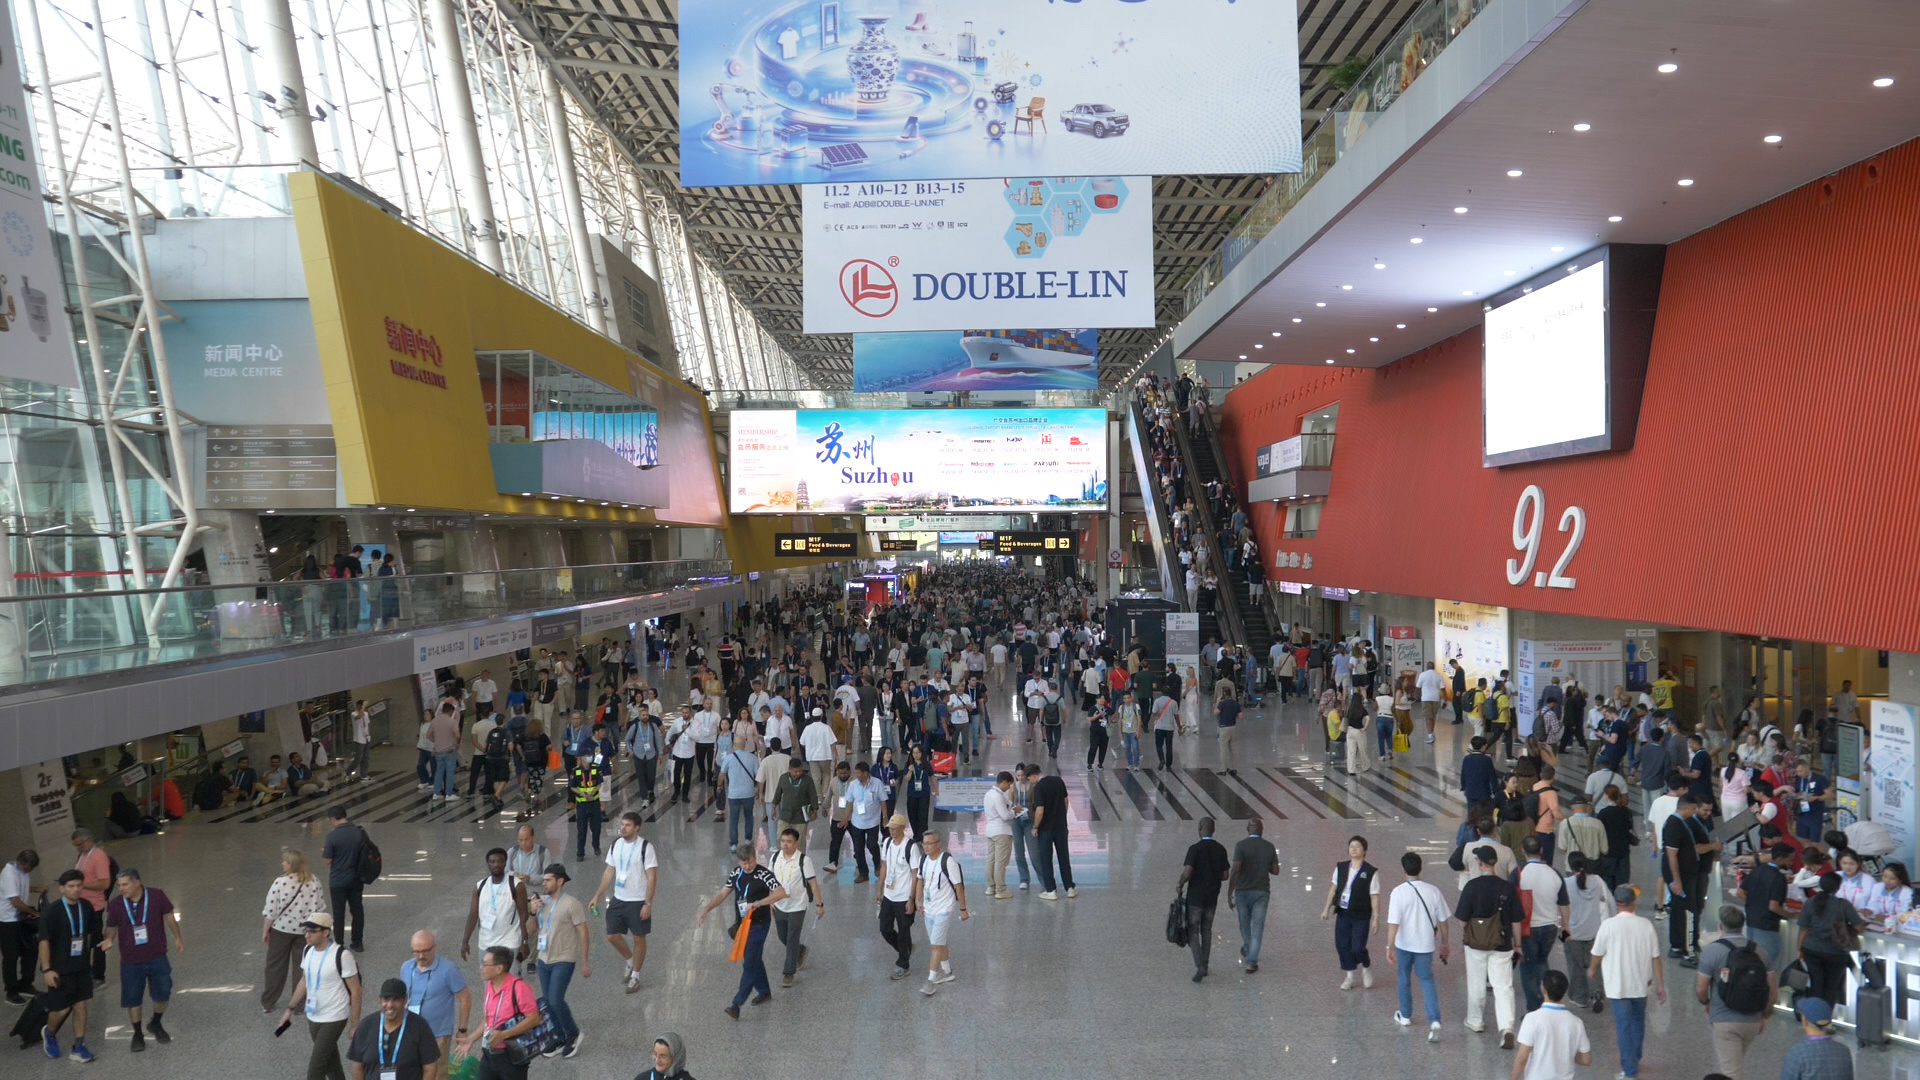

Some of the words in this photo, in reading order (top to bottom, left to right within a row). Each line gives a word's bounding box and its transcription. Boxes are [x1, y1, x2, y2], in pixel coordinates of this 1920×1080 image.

[824, 185, 850, 197] 11.2
[912, 269, 1129, 301] DOUBLE-LIN
[384, 315, 443, 367] 新闻中心
[204, 343, 284, 362] 新闻中心
[204, 367, 238, 377] MEDIA
[242, 366, 283, 377] CENTRE
[816, 421, 875, 466] 苏州
[1506, 484, 1587, 589] 9.2
[1398, 651, 1420, 660] Coffee
[37, 772, 53, 788] 2F
